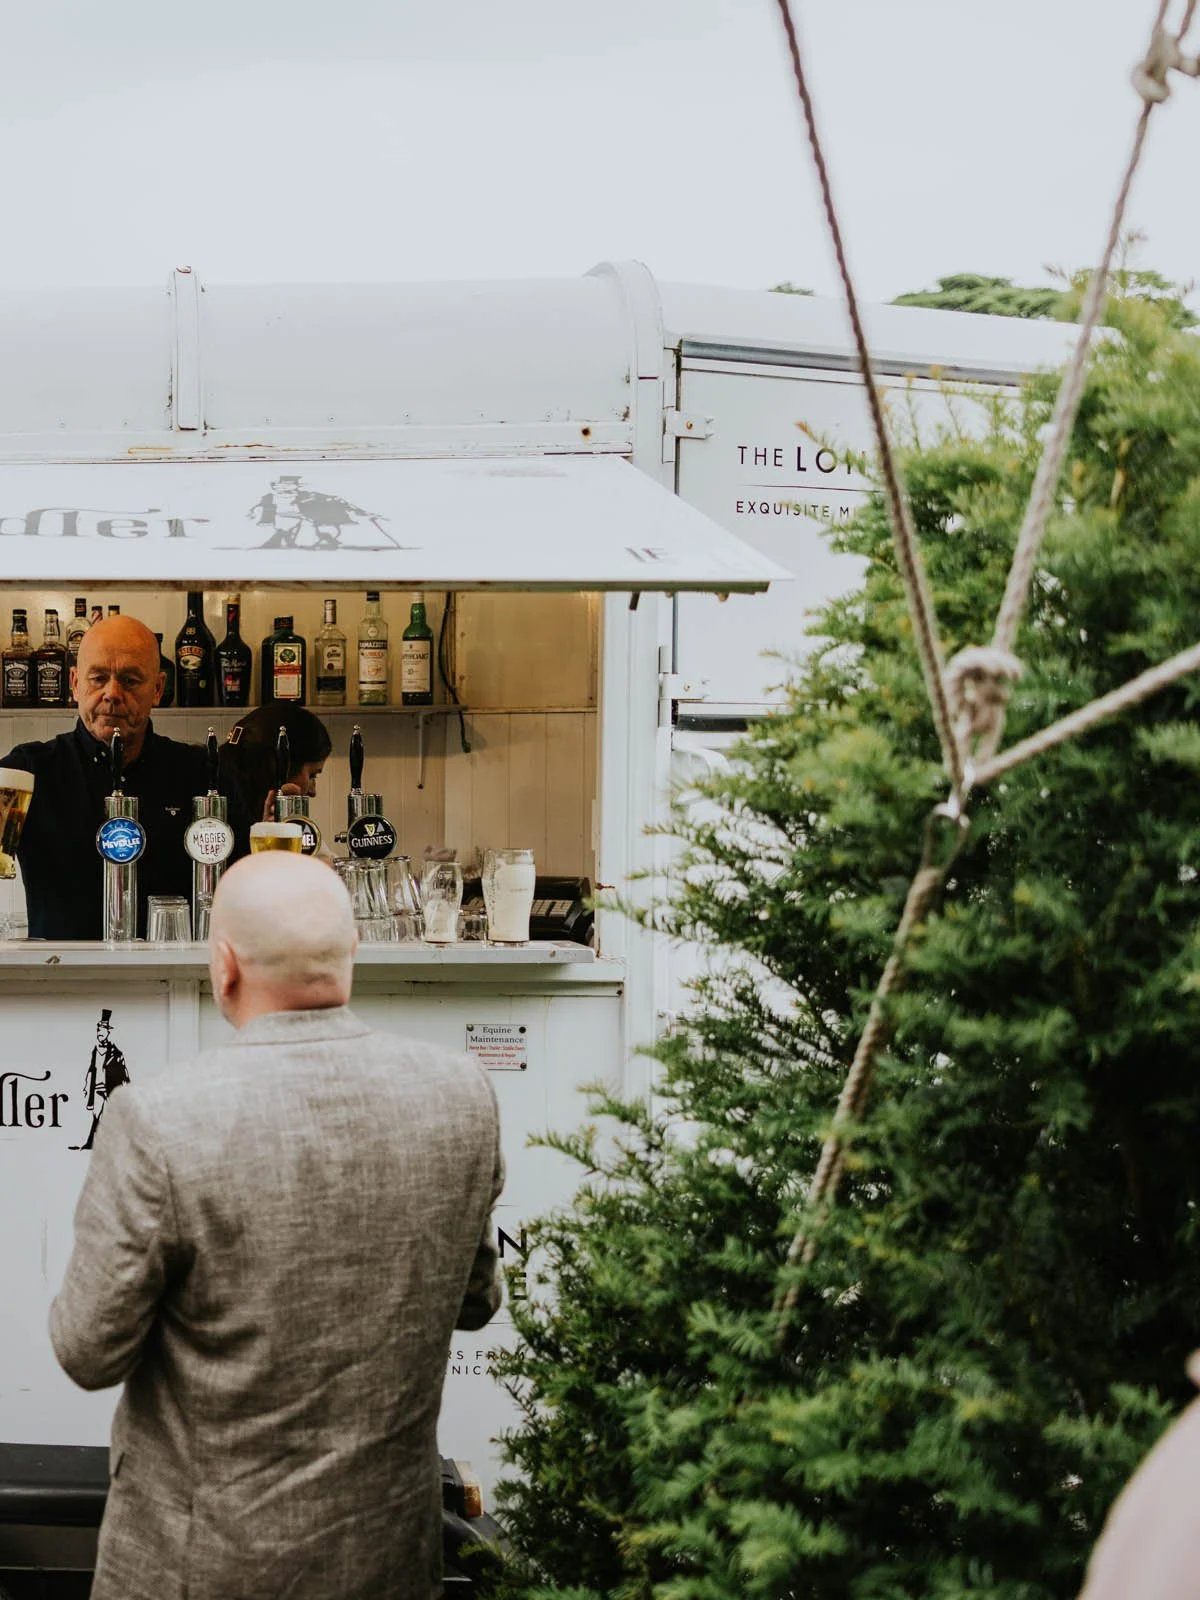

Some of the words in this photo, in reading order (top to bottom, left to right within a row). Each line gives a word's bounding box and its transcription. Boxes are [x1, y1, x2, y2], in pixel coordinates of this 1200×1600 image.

[737, 445, 784, 467] THE
[736, 501, 830, 518] EXQUISITE
[351, 834, 392, 848] GUINNESS
[483, 1027, 512, 1035] Equine
[470, 1035, 524, 1043] Maintenance
